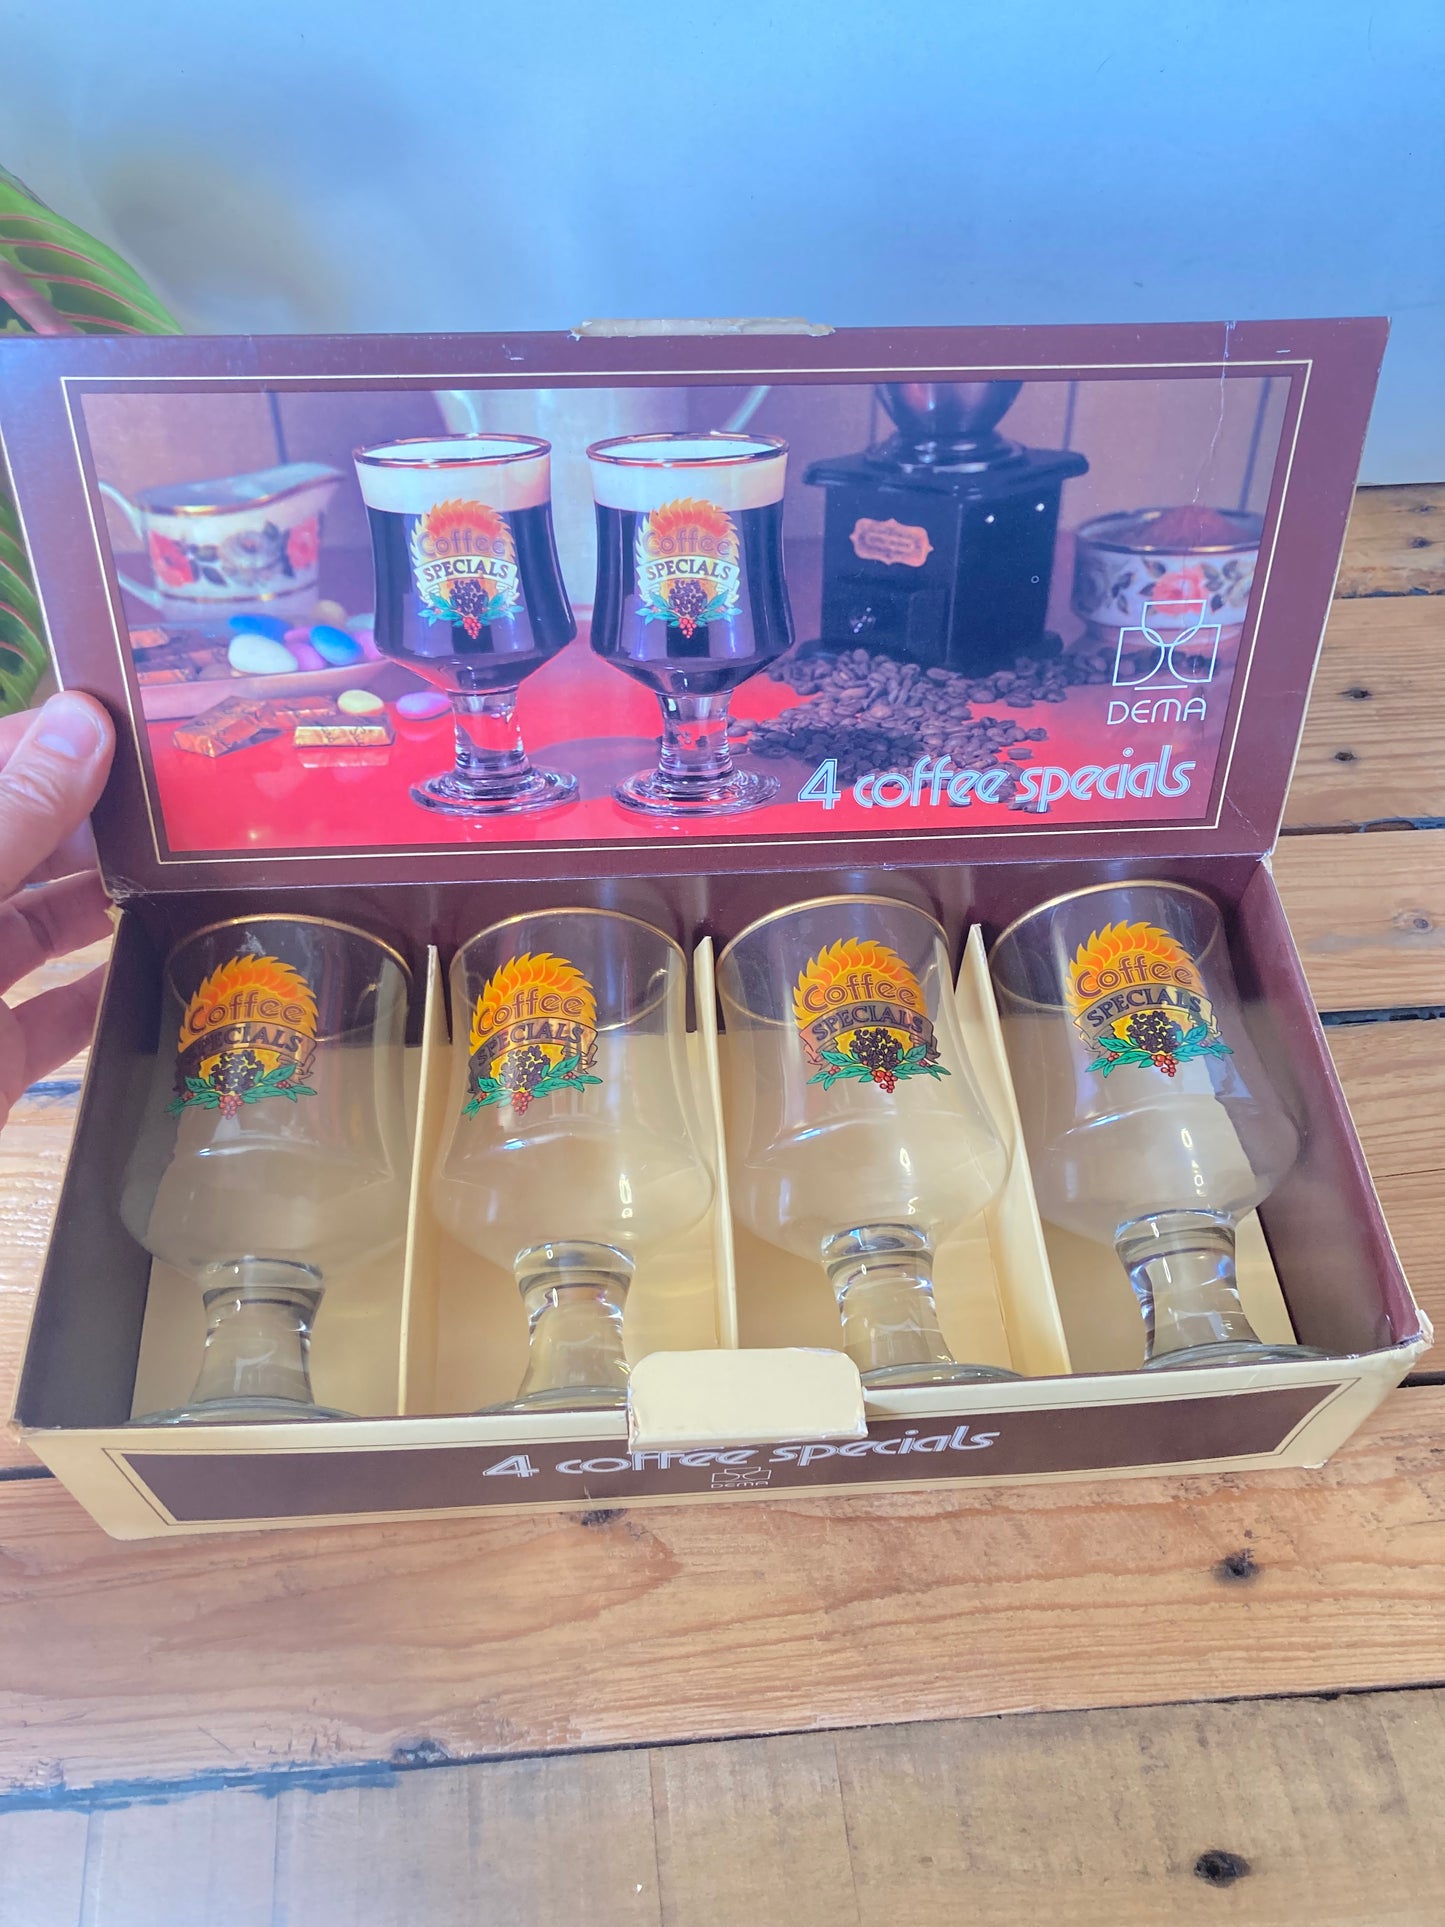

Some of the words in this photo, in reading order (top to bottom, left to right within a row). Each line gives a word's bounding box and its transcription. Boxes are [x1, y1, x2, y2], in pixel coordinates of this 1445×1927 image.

[417, 528, 506, 559] Coffee
[643, 527, 732, 557] Coffee
[423, 558, 509, 582] SPECIALS
[646, 558, 732, 581] SPECIALS
[1106, 697, 1208, 725] DEMA
[798, 758, 841, 810] 4
[853, 754, 1011, 808] coffee
[1015, 744, 1197, 812] specials
[803, 972, 918, 1014] Coffee
[1075, 954, 1194, 1000] Coffee
[189, 989, 307, 1034] Coffee
[477, 987, 586, 1038] Coffee
[811, 1005, 924, 1042] SPECIALS
[1086, 988, 1202, 1028] SPECIALS
[477, 1021, 584, 1067] SPECIALS
[482, 1454, 540, 1478] 4
[769, 1425, 1000, 1467] specials
